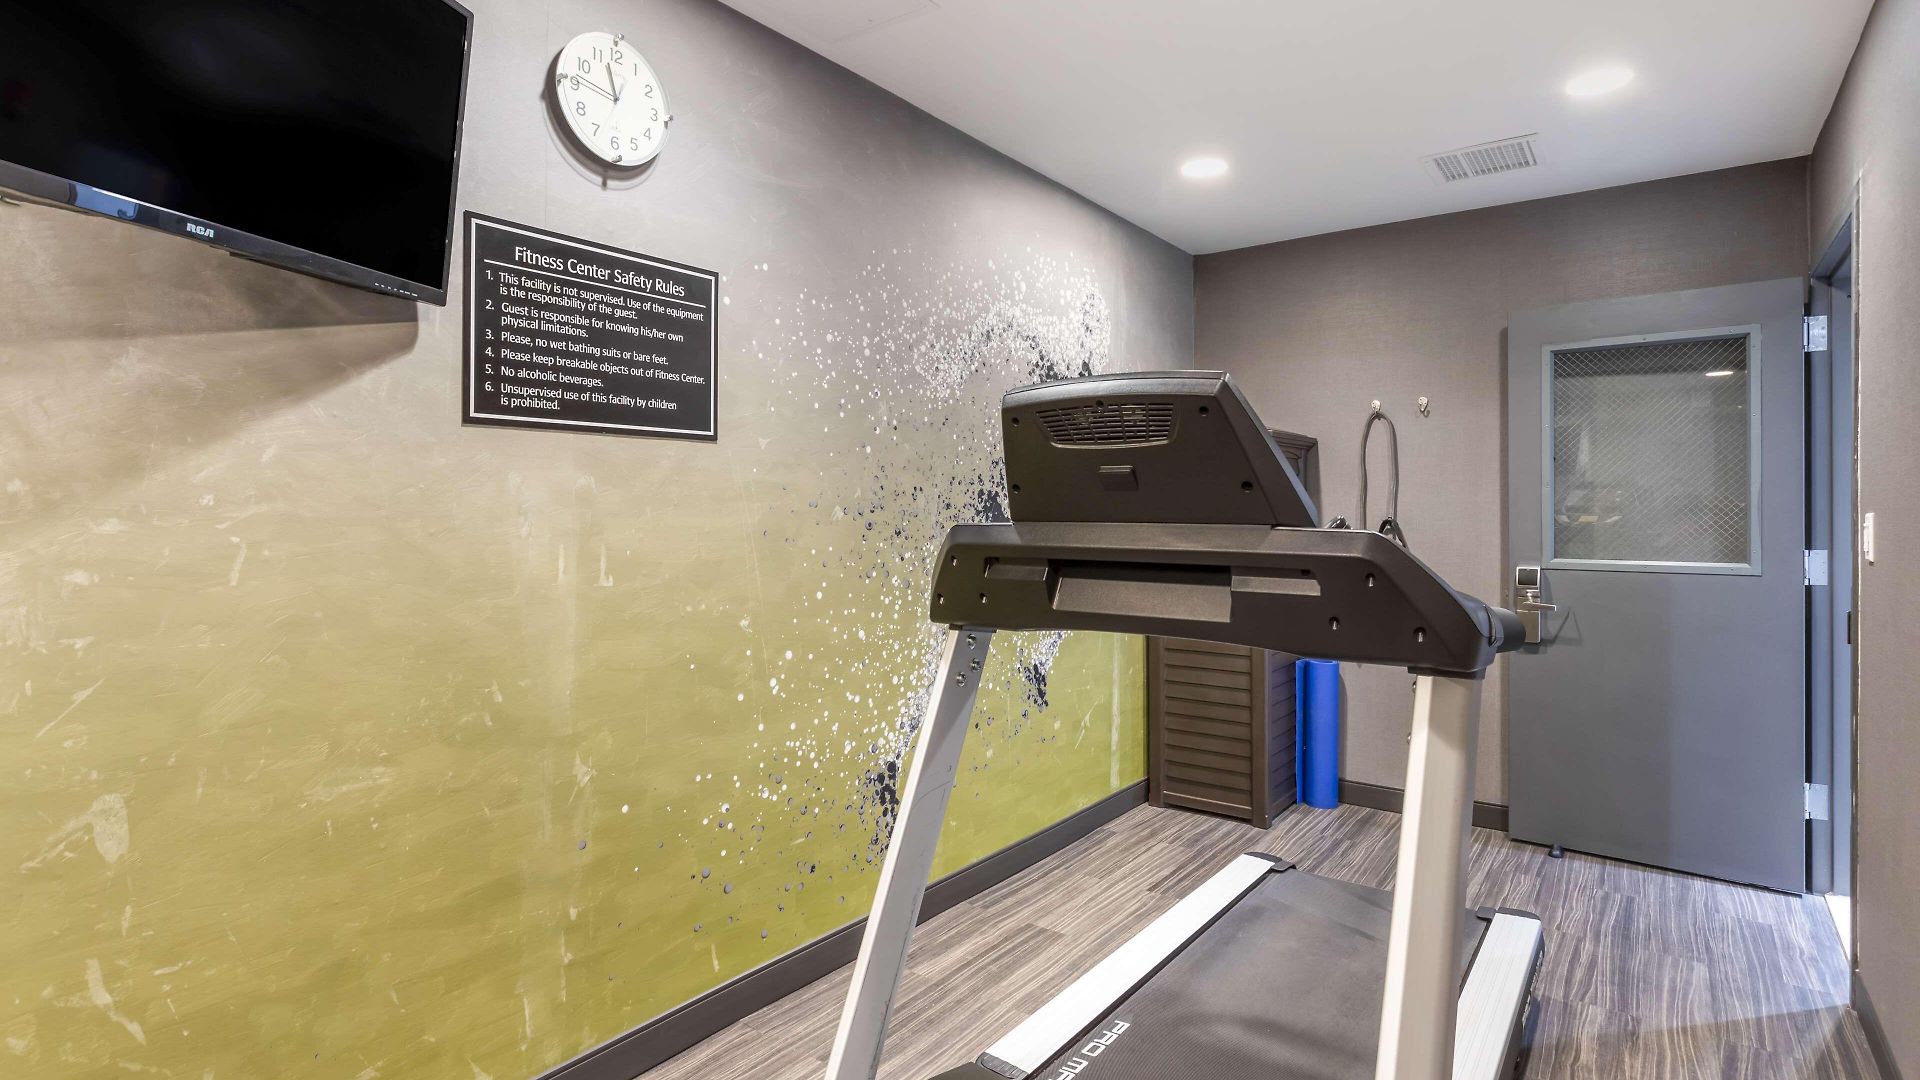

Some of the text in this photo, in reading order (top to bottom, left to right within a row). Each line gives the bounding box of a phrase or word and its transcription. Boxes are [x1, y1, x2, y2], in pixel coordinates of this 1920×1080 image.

[592, 46, 603, 63] 11
[610, 47, 623, 66] 12
[577, 56, 591, 75] 10
[570, 76, 580, 91] 9
[644, 84, 653, 99] 2
[576, 101, 586, 117] 8
[650, 107, 658, 122] 3
[591, 122, 601, 137] 7
[643, 127, 652, 141] 4
[610, 136, 620, 151] 6
[630, 137, 639, 151] 5
[186, 222, 214, 238] RCA
[515, 246, 685, 297] Fitness Center Safety Rules
[485, 270, 704, 321] 1. This facility is not supervised. Use of the equipment
[500, 284, 638, 319] is the responsibility of the guest.
[485, 299, 684, 342] 2. Guest is responsible for knowing his/her own
[501, 315, 589, 337] physical limitations.
[485, 329, 669, 365] 3. Please, no wet bathing suits or bare feet.
[485, 346, 705, 384] 4. Please keep breakable objects out of Fitness Center.
[485, 364, 604, 387] 5. No alcoholic beverages.
[485, 381, 677, 410] 6. Unsupervised use of this facility by children
[500, 394, 560, 410] is prohibited.
[1081, 1020, 1131, 1057] PRO
